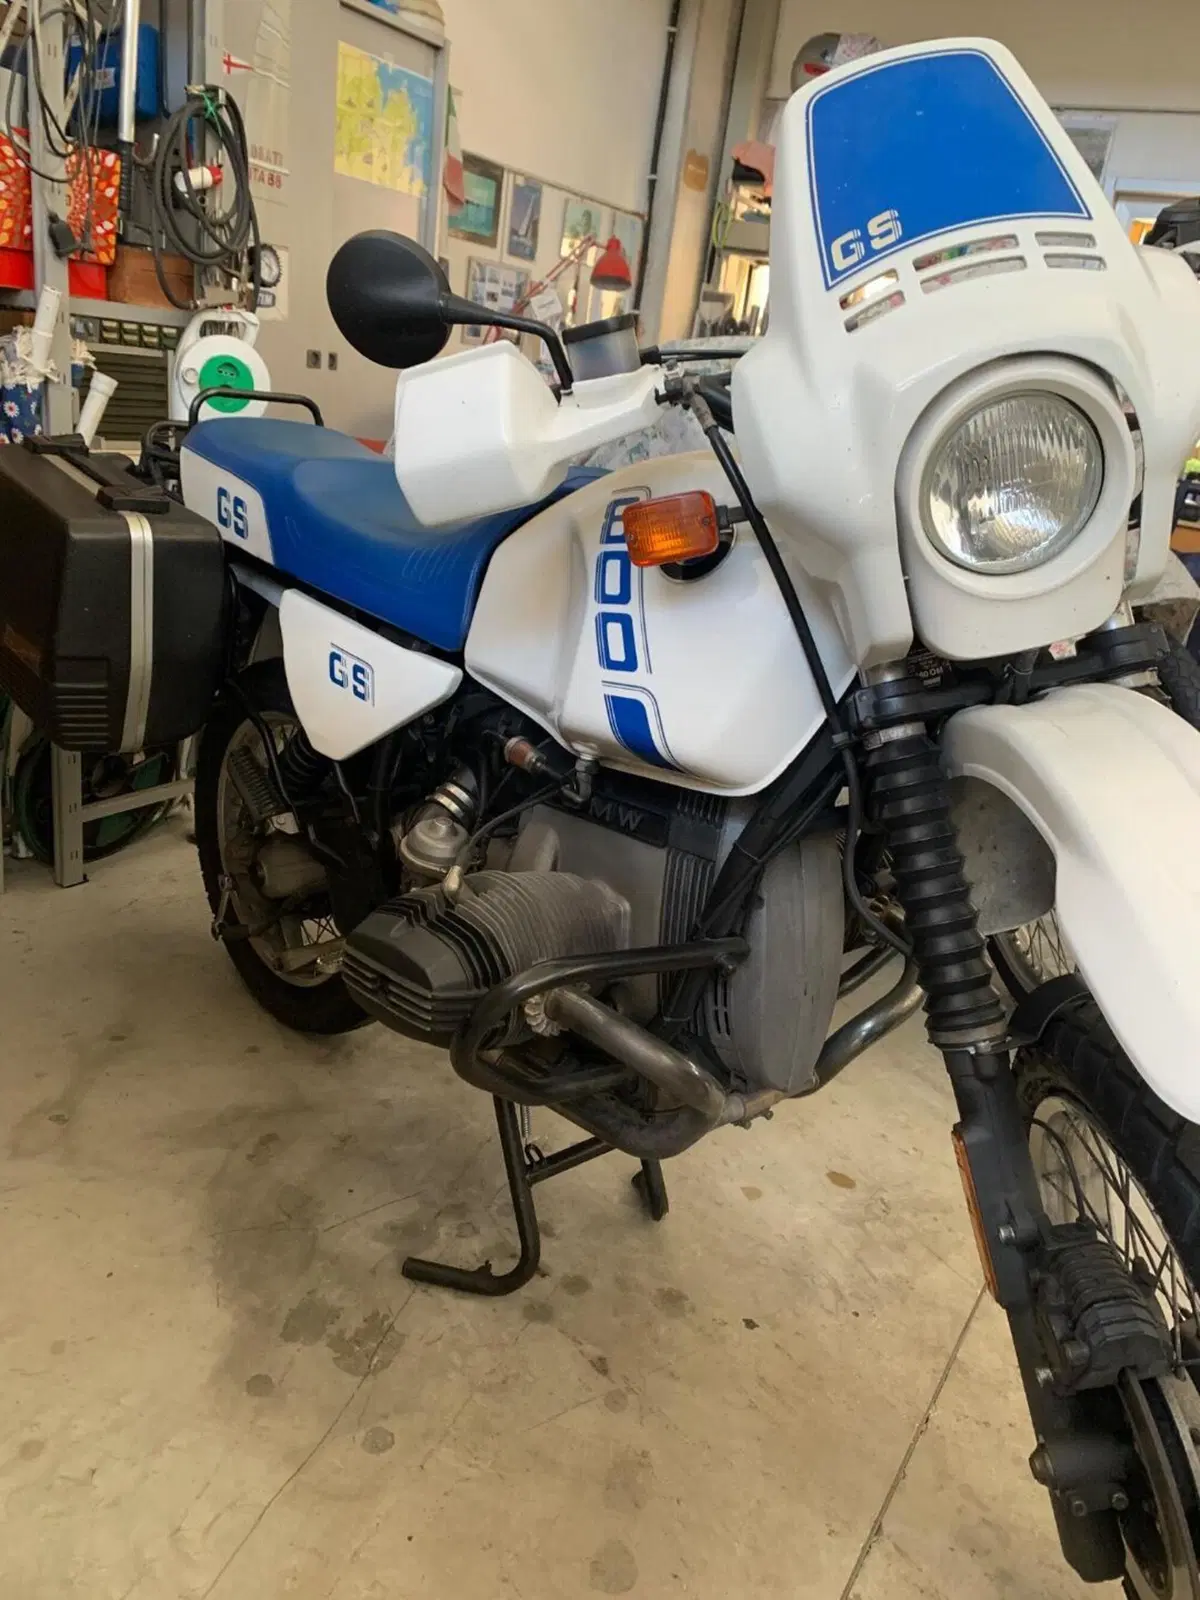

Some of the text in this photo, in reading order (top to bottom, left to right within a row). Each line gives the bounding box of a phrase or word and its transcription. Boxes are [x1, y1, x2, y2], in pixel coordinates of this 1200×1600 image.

[831, 209, 902, 271] GS
[217, 486, 249, 540] GS
[329, 651, 370, 702] GS
[588, 796, 643, 831] MW
